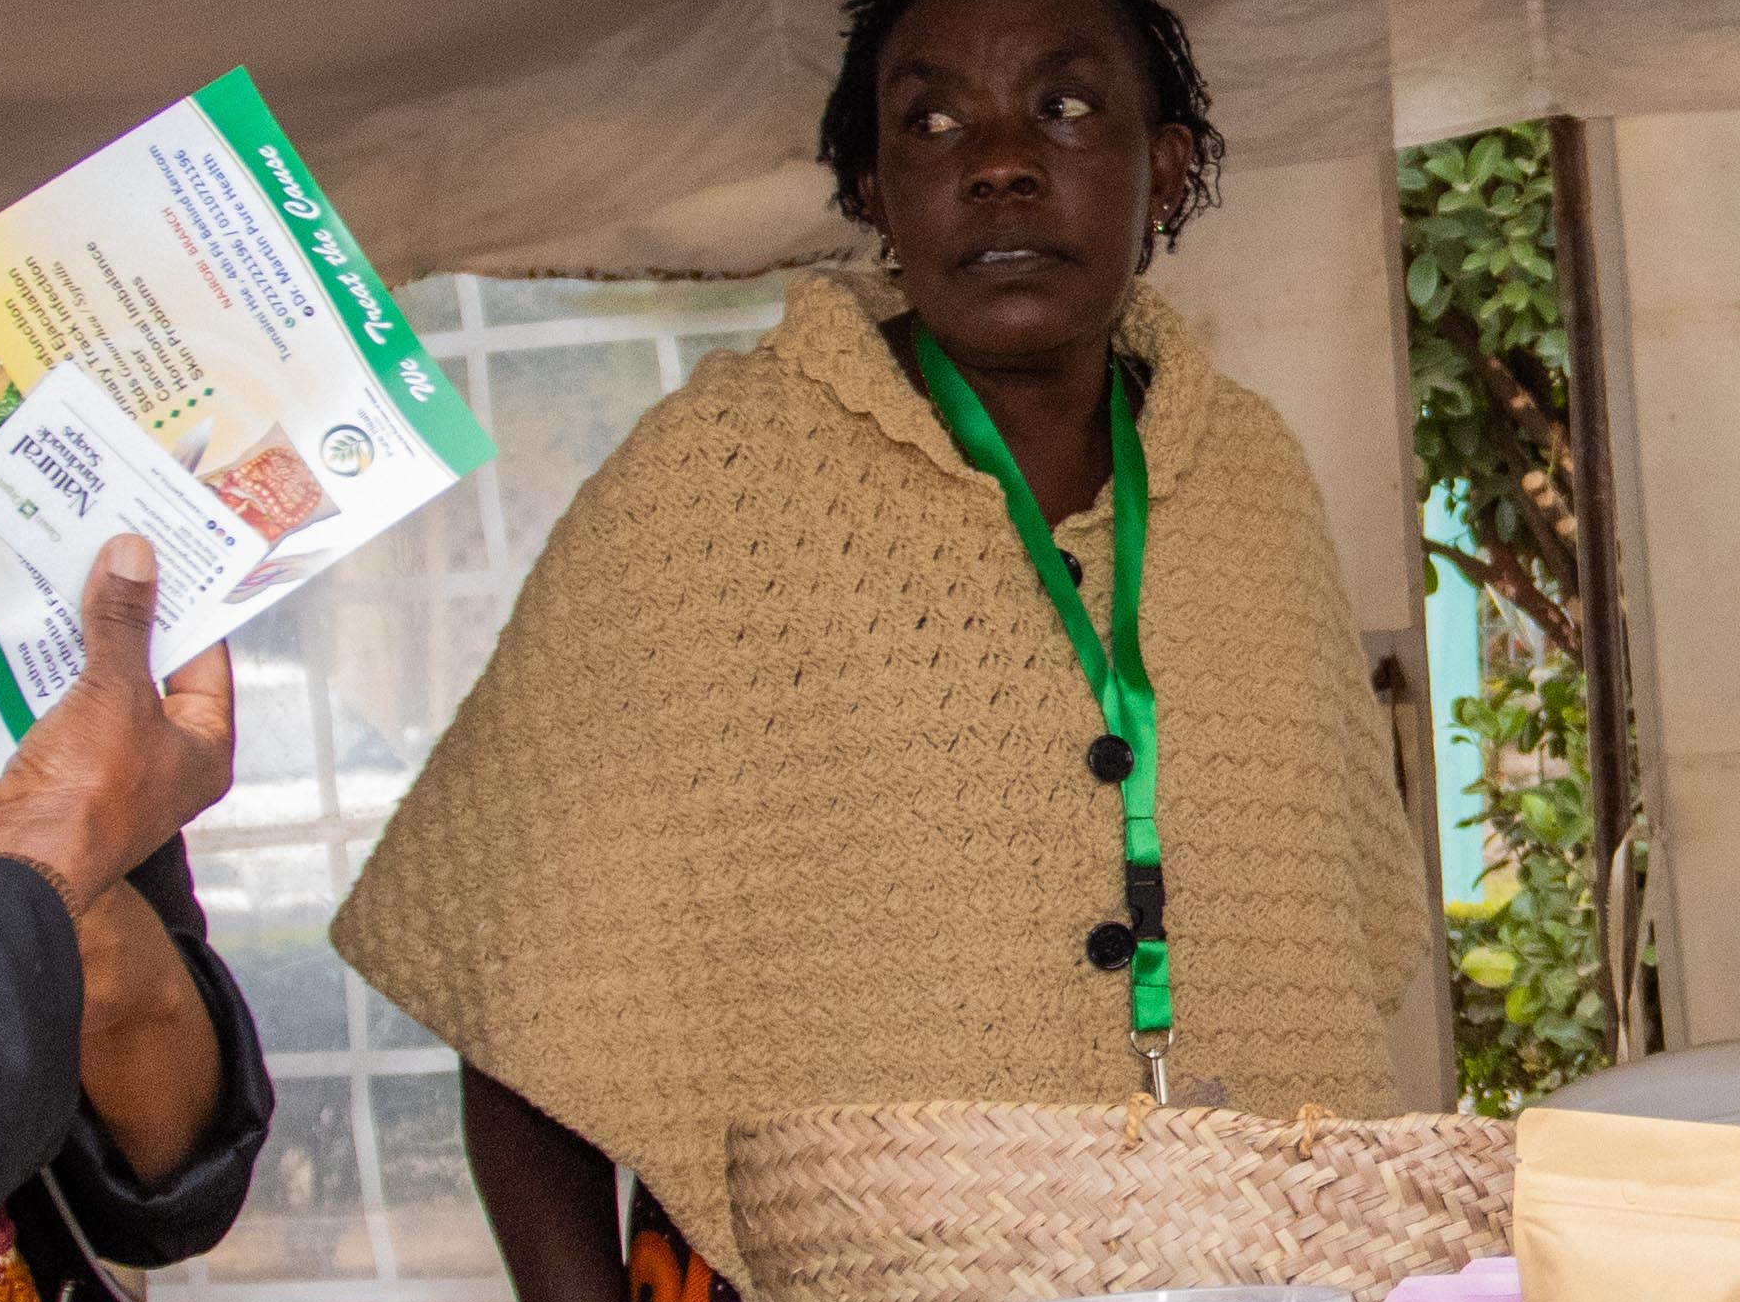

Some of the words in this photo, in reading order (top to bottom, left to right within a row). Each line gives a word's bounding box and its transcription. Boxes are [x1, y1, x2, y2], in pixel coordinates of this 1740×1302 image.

[148, 144, 184, 195] Kencom
[173, 148, 229, 228] 0110721196
[203, 152, 236, 200] Health
[257, 144, 323, 220] Cause
[161, 206, 198, 255] BRANCH
[177, 195, 212, 239] Behind
[234, 201, 259, 235] Pure
[208, 241, 224, 257] Flr
[220, 257, 237, 278] 4th
[256, 235, 291, 284] Martin
[312, 228, 348, 266] the
[25, 255, 71, 322] Infection
[53, 260, 86, 307] Syphilis
[86, 241, 139, 319] Imbalance
[195, 258, 233, 309] NAIROBI
[230, 238, 288, 317] 0721721196
[240, 287, 259, 311] Hse
[289, 284, 306, 306] Dr.
[8, 267, 66, 351] Ejaculation
[133, 275, 181, 347] Problems
[336, 270, 393, 344] Treat
[67, 322, 99, 368] Track
[87, 315, 131, 377] Gonorrhea
[133, 318, 188, 392] Hormonal
[254, 311, 291, 362] Tumaini
[130, 349, 170, 402] Cancer
[178, 346, 203, 380] Skin
[391, 358, 435, 402] We
[129, 377, 154, 413] Stds
[39, 428, 105, 493] Handmade
[63, 427, 101, 468] Soaps
[11, 433, 88, 517] Natural
[18, 641, 50, 697] Asthma
[37, 638, 65, 689] Ulcers
[46, 617, 85, 676] Arthritis
